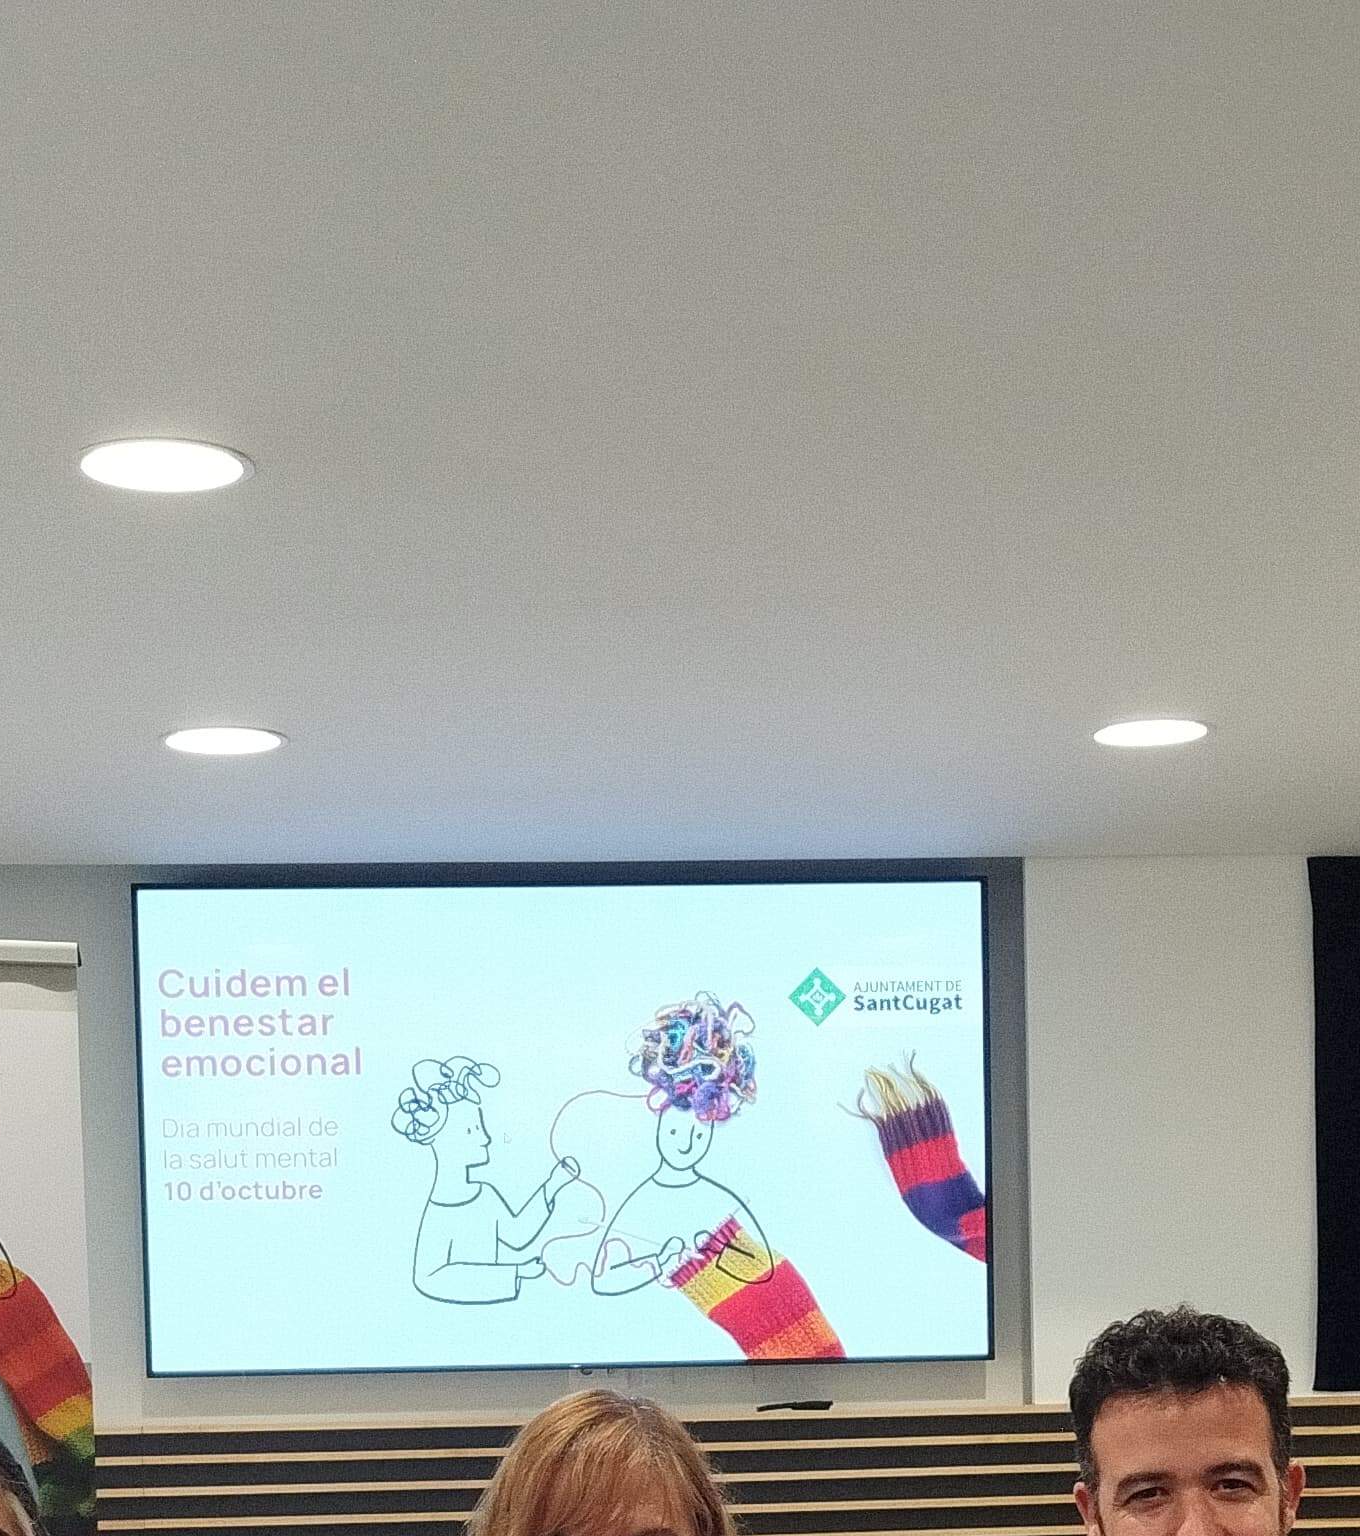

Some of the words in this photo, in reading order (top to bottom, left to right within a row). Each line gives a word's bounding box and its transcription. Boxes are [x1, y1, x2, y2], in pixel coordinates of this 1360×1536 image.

[158, 968, 307, 998] Cuidem
[318, 967, 350, 997] el
[853, 980, 941, 993] AJUNTAMENT
[945, 979, 962, 992] DE
[853, 994, 963, 1015] SantCugat
[160, 1008, 334, 1038] benestar
[161, 1046, 361, 1077] emocional
[162, 1118, 200, 1138] Dia
[207, 1116, 301, 1137] mundial
[308, 1116, 339, 1137] de
[163, 1149, 183, 1170] la
[189, 1149, 248, 1170] salut
[255, 1147, 338, 1169] mental
[164, 1181, 191, 1201] 10
[199, 1180, 323, 1201] d'octubre
